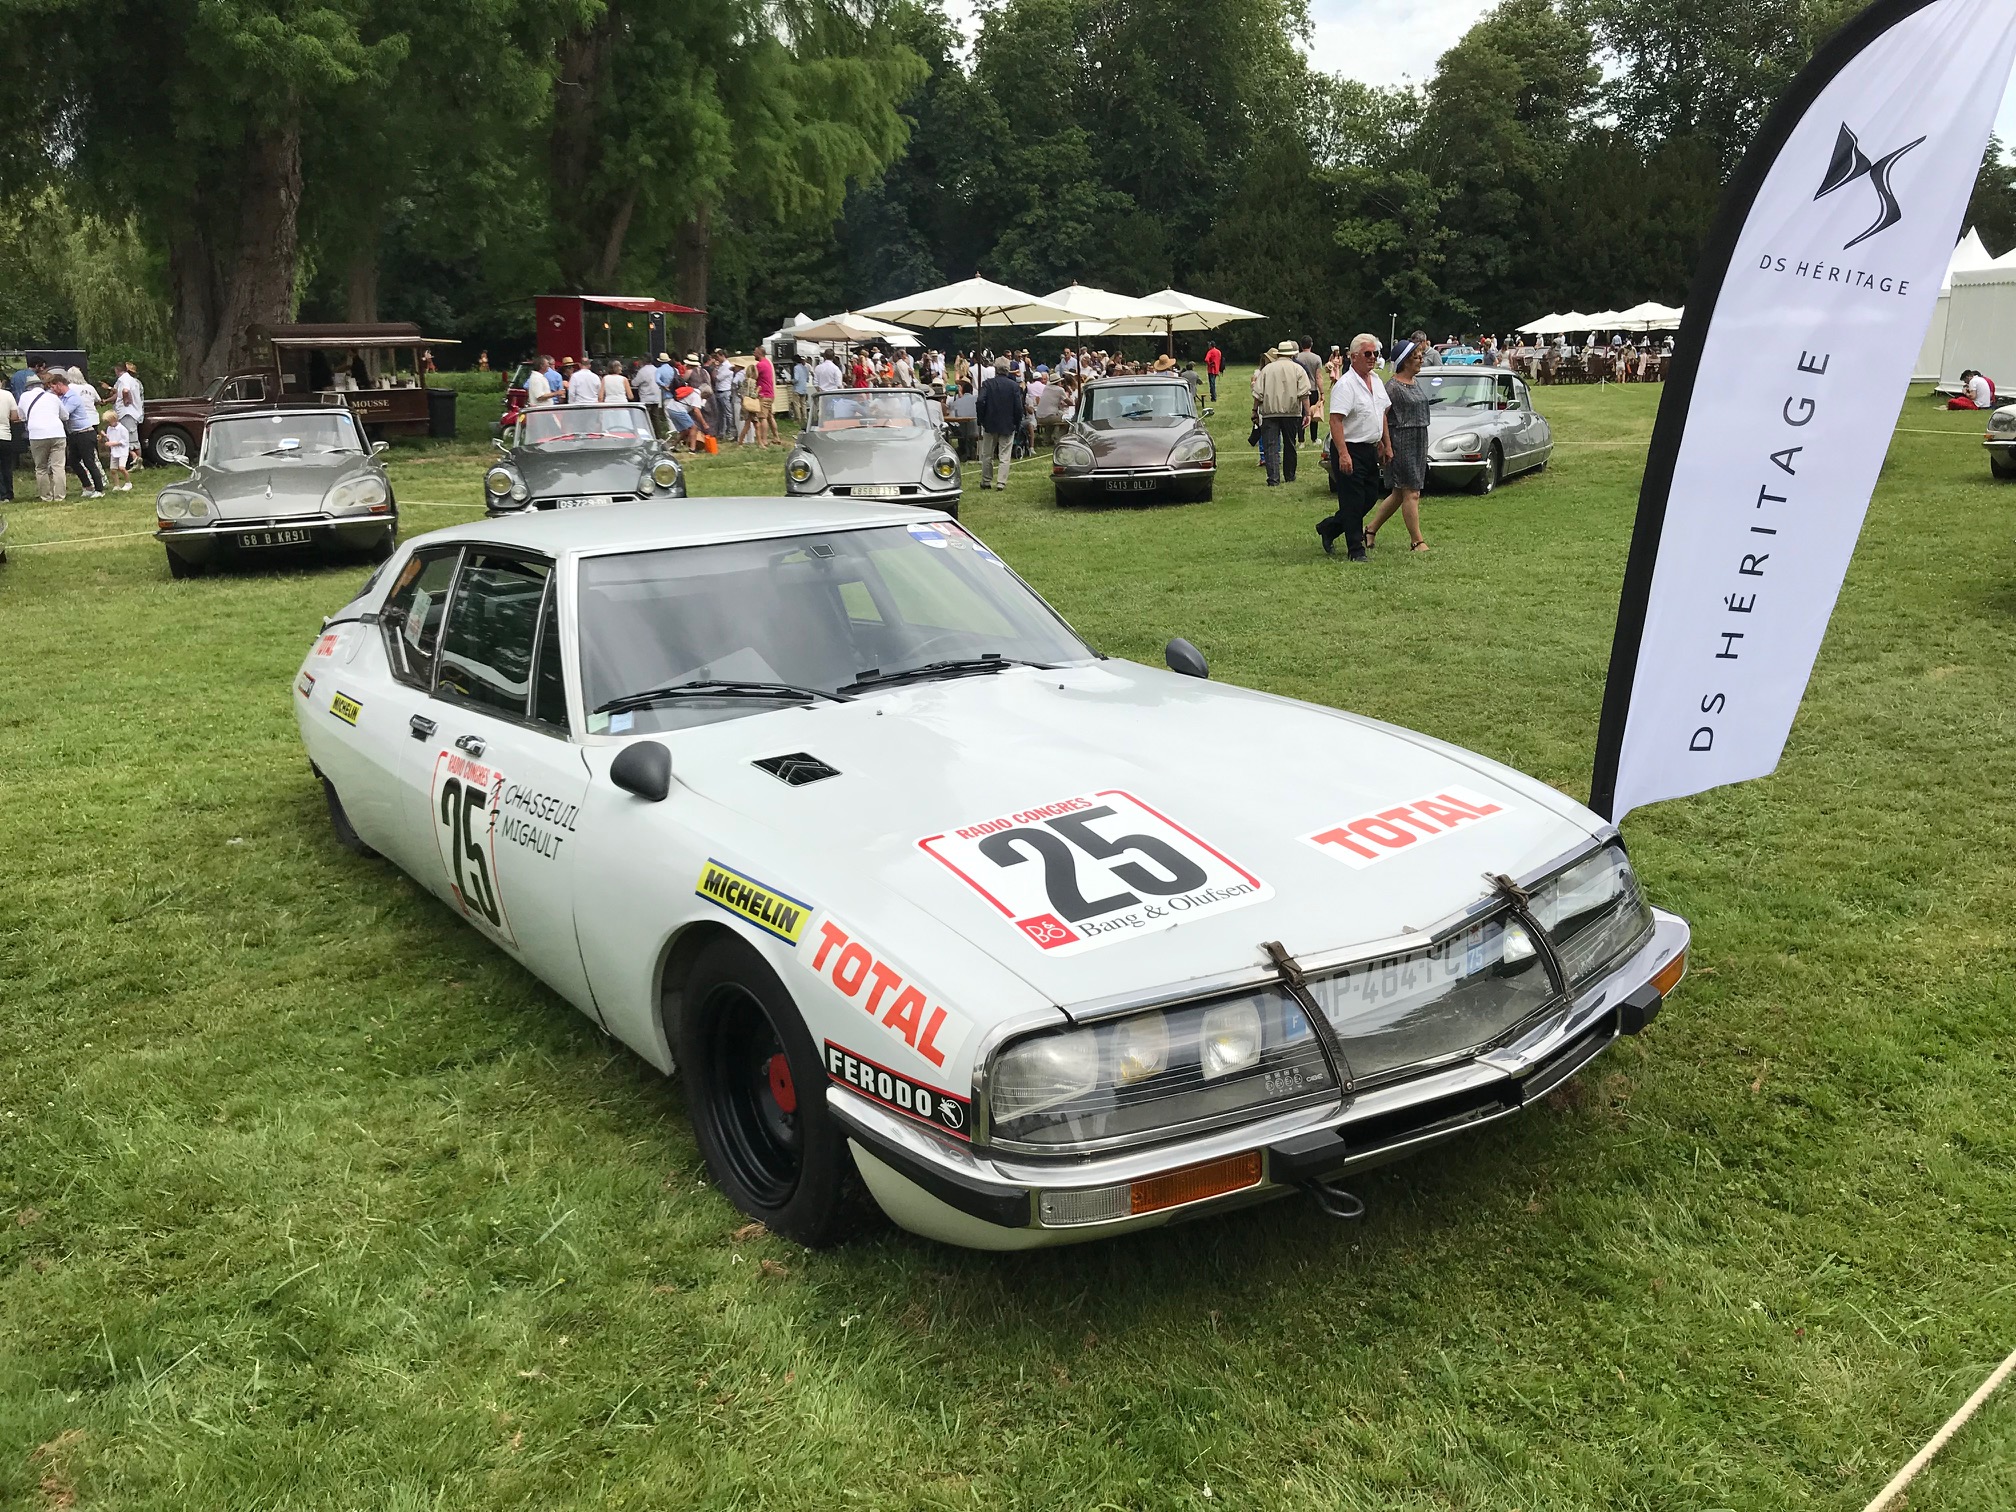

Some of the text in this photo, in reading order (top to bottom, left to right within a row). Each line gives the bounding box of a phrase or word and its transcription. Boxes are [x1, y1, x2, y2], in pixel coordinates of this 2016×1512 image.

[1759, 254, 1910, 296] DS HÉRITAGE
[351, 399, 390, 408] MOUSSE
[243, 534, 258, 546] 68
[277, 529, 305, 543] KR91
[1688, 350, 1831, 752] DS HÉRITAGE
[332, 695, 360, 721] MICHELIN
[447, 753, 491, 787] RADIO CONGRES
[505, 784, 580, 832] CHASSEUIL
[955, 797, 1093, 840] RADIO CONGRES
[1310, 794, 1503, 859] TOTAL
[441, 777, 501, 927] 25
[501, 814, 563, 861] MIGAULT
[978, 805, 1208, 924] 25
[703, 868, 800, 933] MICHELIN
[1076, 879, 1255, 938] Bang & Olufsen
[1468, 948, 1483, 971] 75
[811, 919, 948, 1068] TOTAL
[1292, 1016, 1299, 1029] F
[828, 1047, 932, 1117] FERODO
